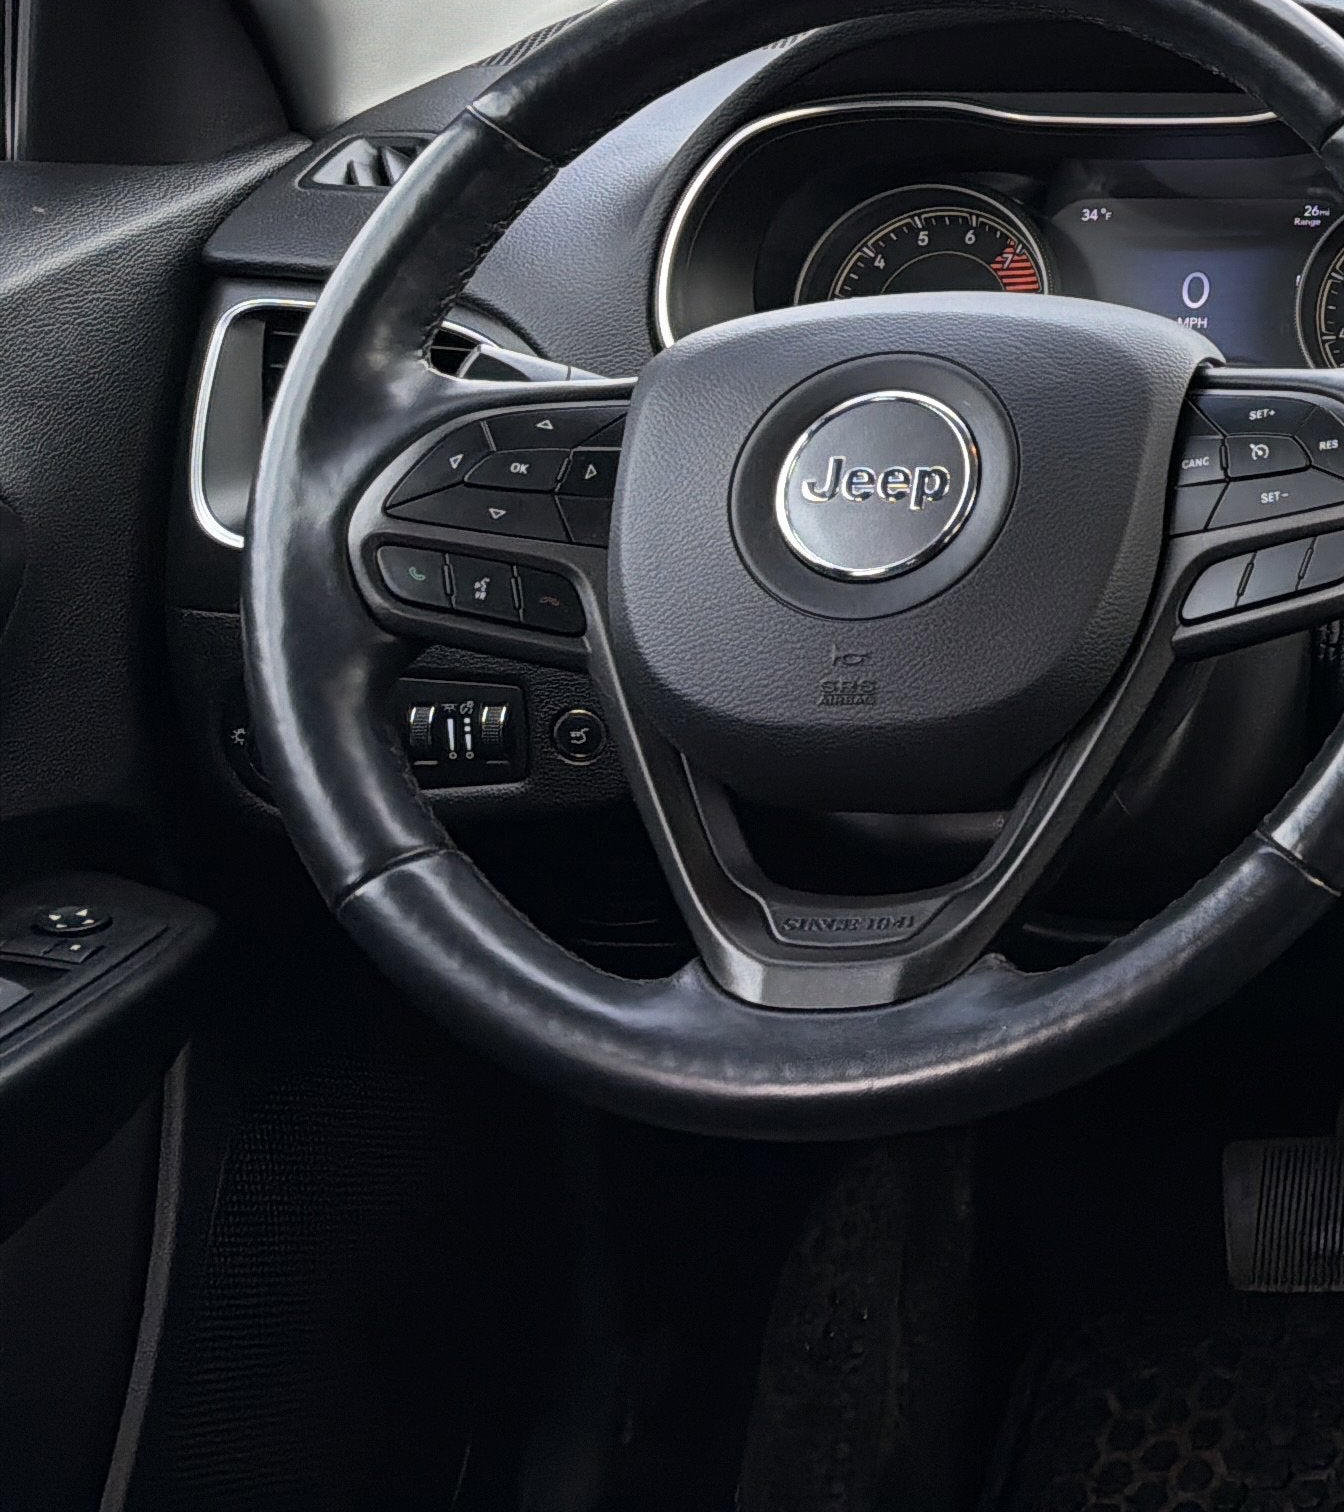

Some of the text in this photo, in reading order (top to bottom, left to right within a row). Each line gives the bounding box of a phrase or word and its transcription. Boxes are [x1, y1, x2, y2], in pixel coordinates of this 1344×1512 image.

[1294, 217, 1322, 228] Range
[917, 231, 930, 246] 5
[964, 230, 977, 245] 6
[873, 254, 887, 270] 4
[1001, 254, 1014, 270] 7
[1181, 271, 1211, 309] 0
[1176, 316, 1208, 330] MPH
[1248, 408, 1276, 421] SET+
[1319, 439, 1339, 451] RES
[510, 462, 530, 474] OK
[1181, 456, 1210, 470] CANC
[801, 455, 951, 512] Jeep
[781, 917, 860, 931] SINCE
